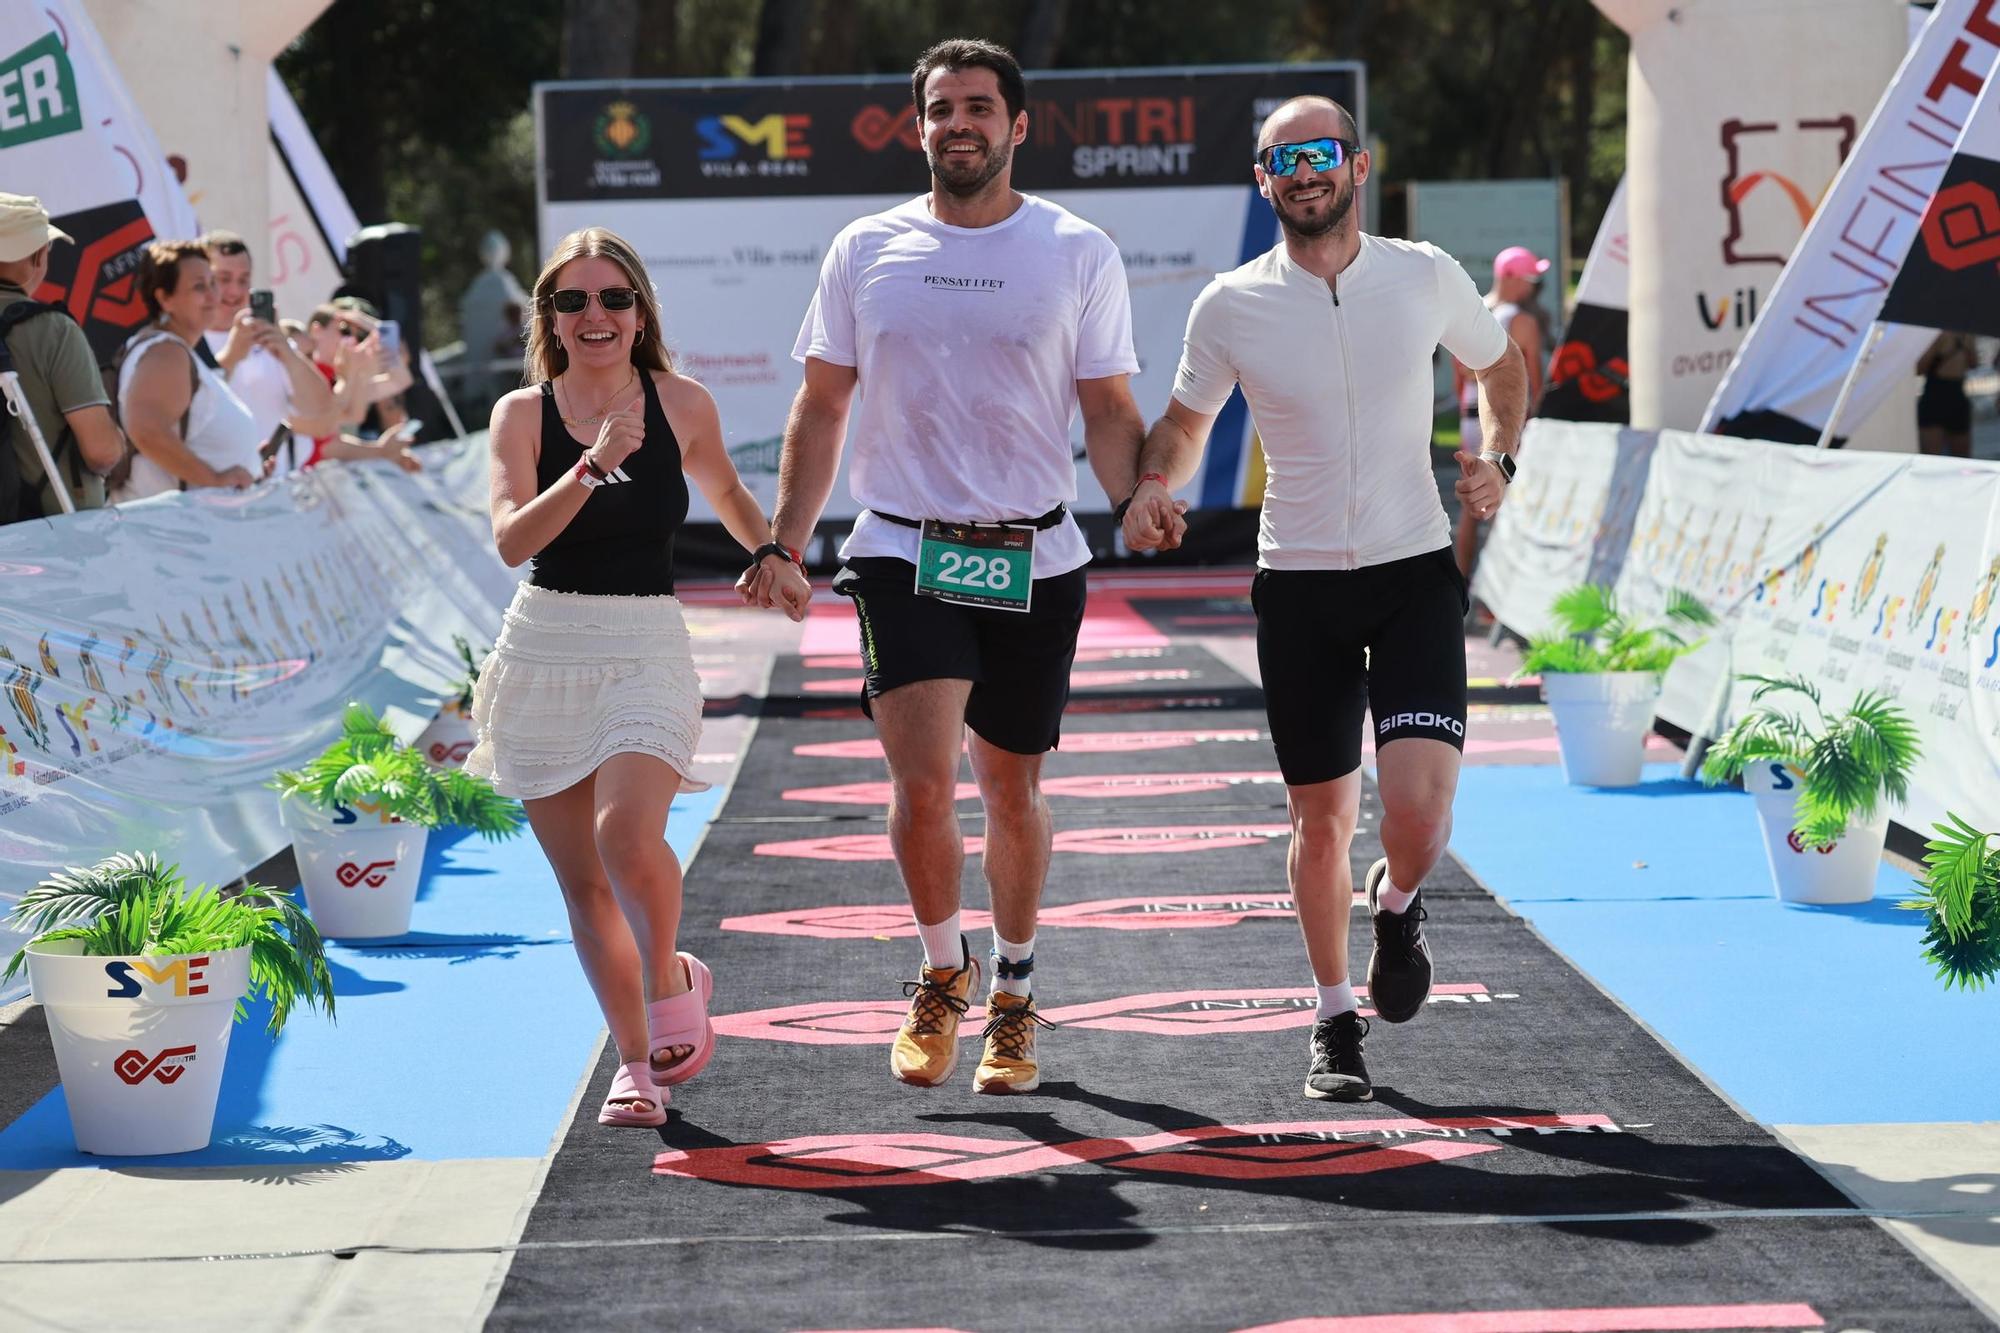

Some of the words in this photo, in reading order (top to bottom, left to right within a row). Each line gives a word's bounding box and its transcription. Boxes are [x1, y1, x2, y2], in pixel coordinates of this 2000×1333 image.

[696, 114, 811, 159] SME
[1073, 145, 1195, 177] SPRINT
[924, 275, 971, 287] PENSAT
[981, 279, 1005, 289] FET
[1697, 286, 1756, 330] Vil
[1672, 350, 1735, 378] avan
[937, 551, 1011, 590] 228
[1380, 712, 1464, 737] SIROKO
[105, 957, 209, 998] SME
